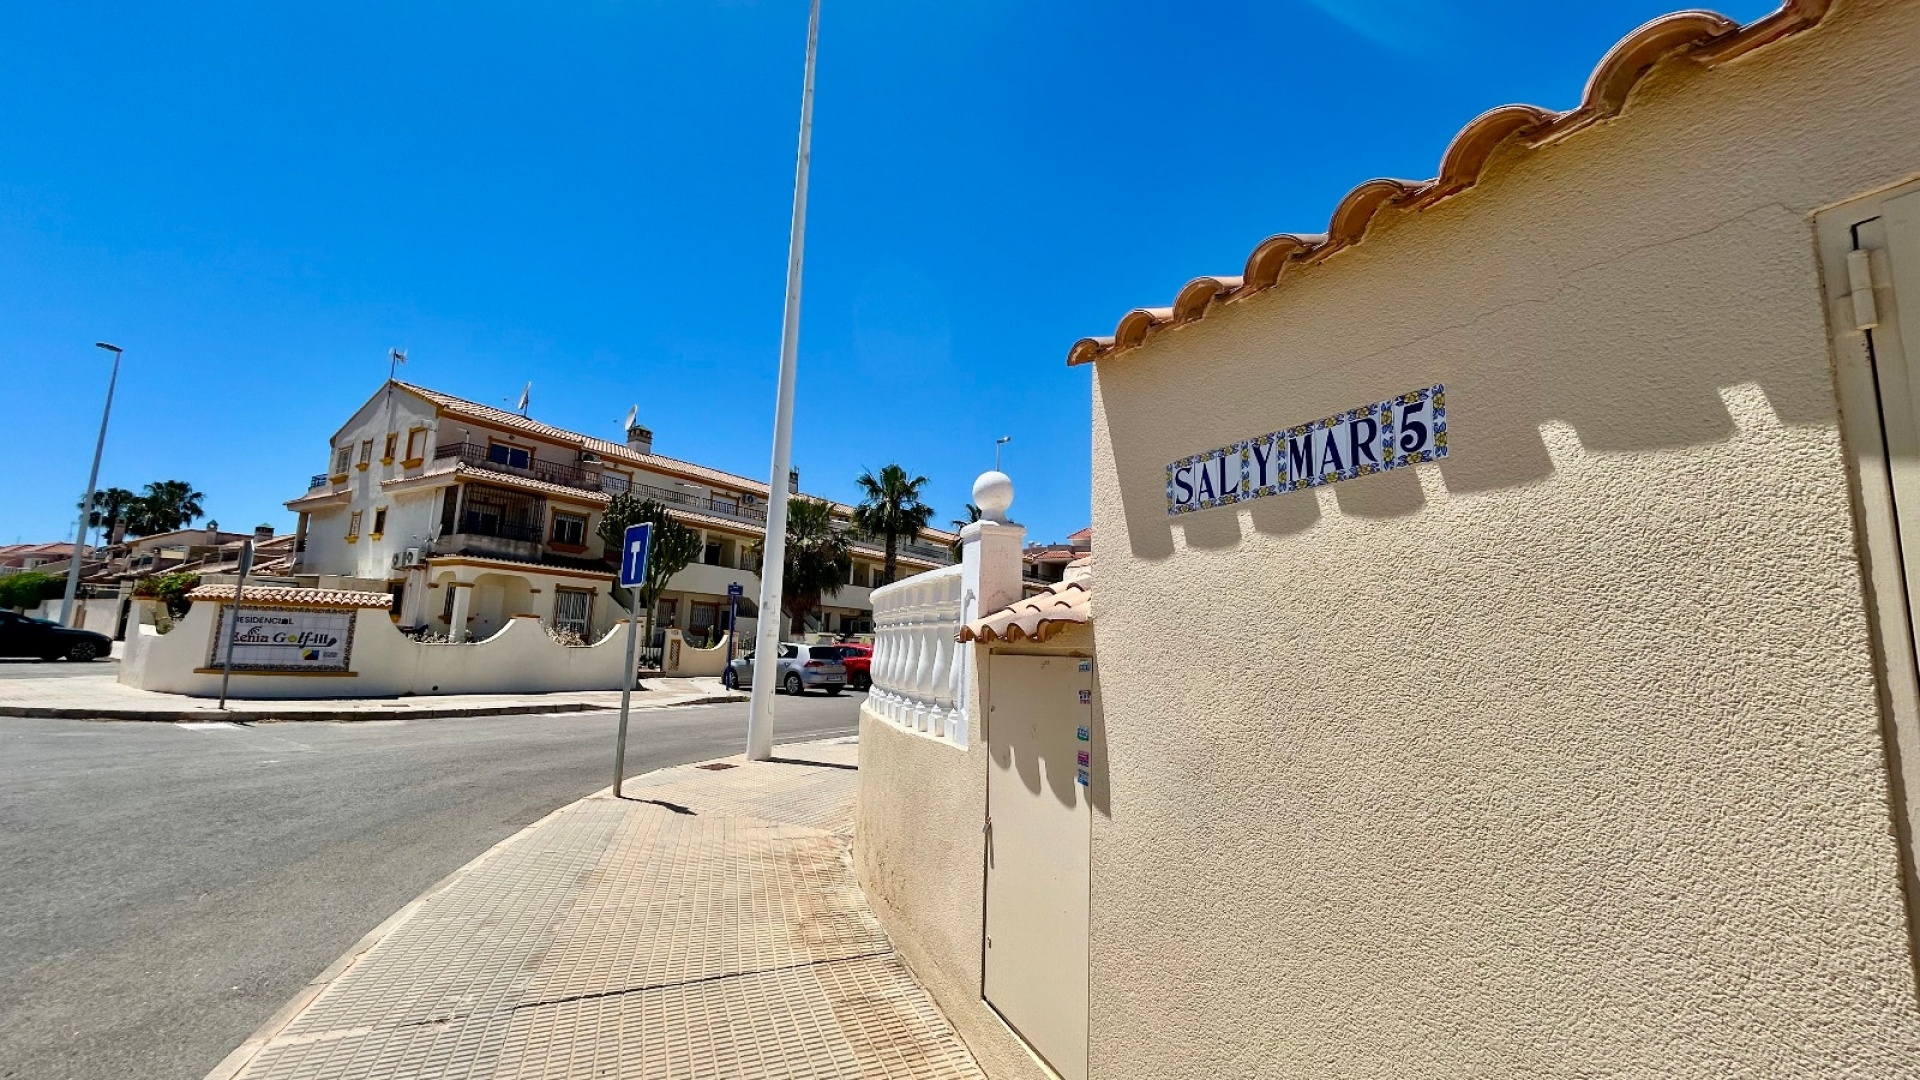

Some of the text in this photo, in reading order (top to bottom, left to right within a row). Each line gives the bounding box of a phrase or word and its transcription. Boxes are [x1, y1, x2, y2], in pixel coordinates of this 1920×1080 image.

[1174, 401, 1428, 505] SAL Y MAR 5
